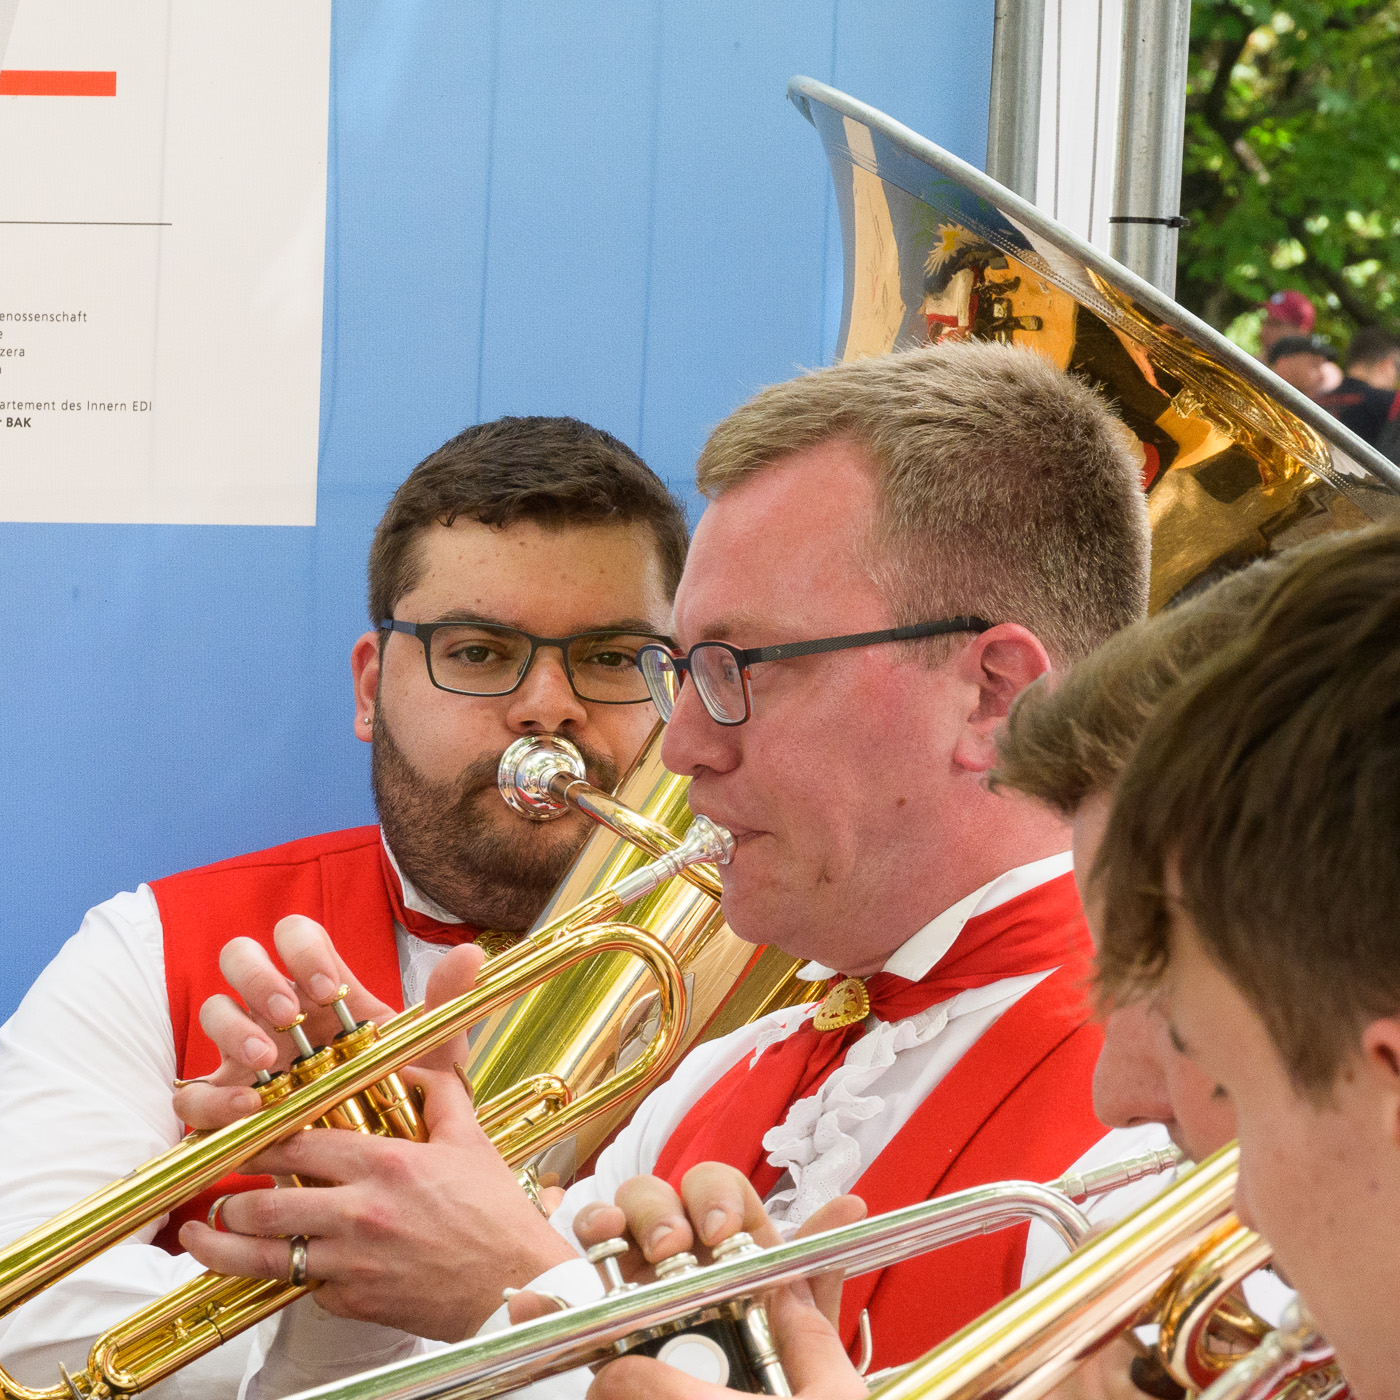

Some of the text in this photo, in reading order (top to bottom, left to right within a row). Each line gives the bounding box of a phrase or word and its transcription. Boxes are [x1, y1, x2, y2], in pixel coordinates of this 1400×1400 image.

[61, 399, 83, 412] des
[87, 400, 128, 412] Innern
[132, 400, 153, 412] EDI
[6, 417, 32, 429] BAK
